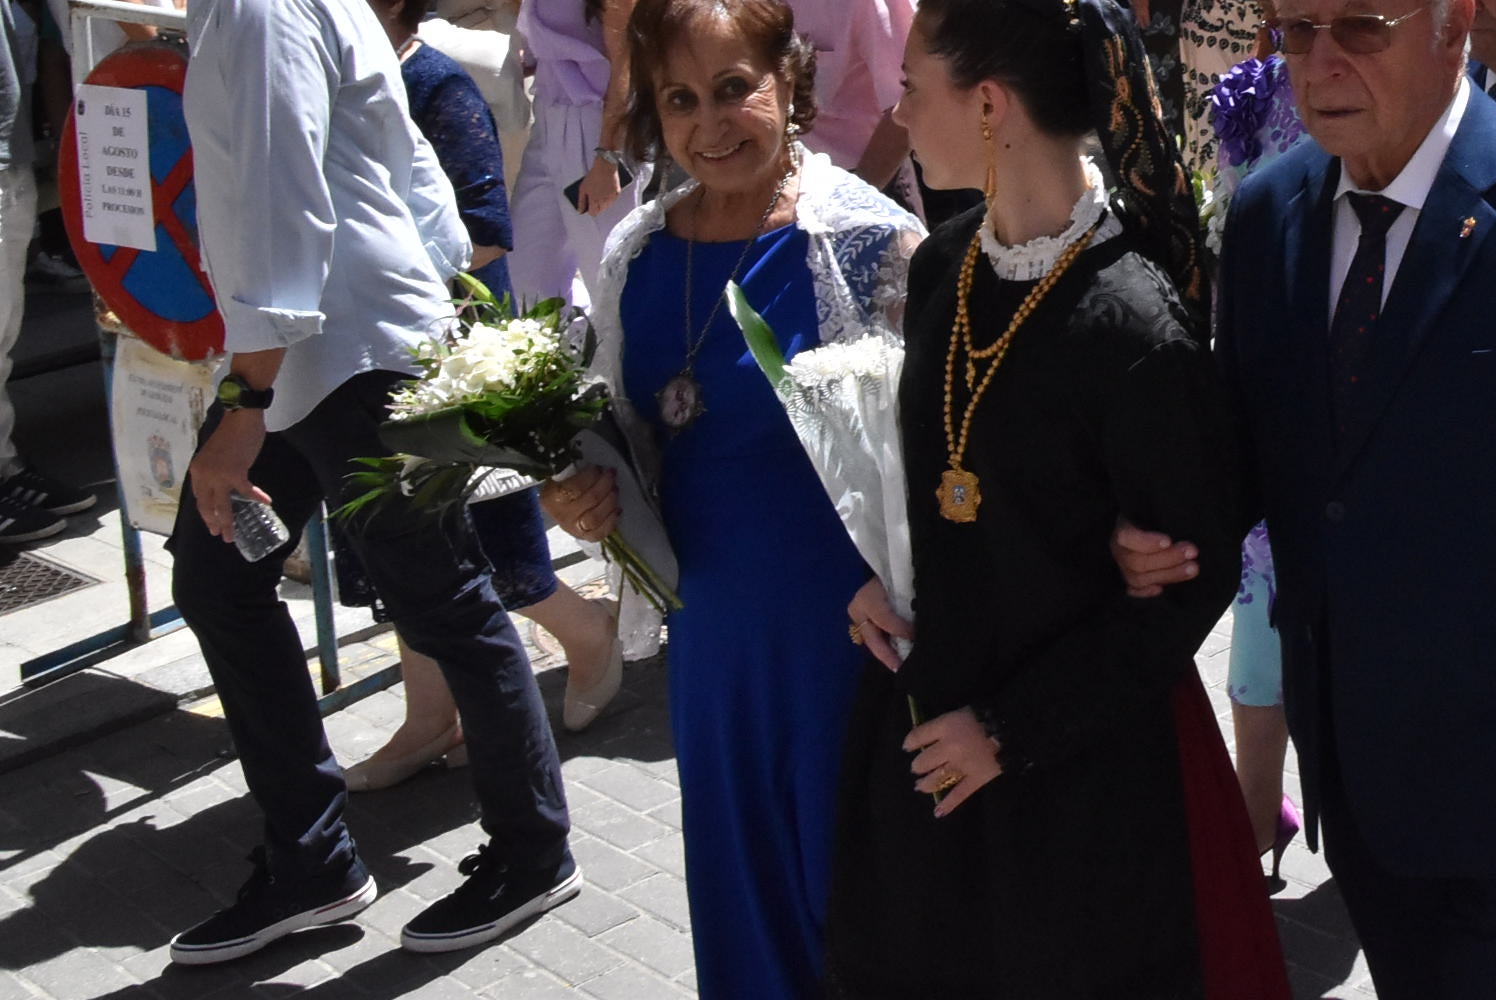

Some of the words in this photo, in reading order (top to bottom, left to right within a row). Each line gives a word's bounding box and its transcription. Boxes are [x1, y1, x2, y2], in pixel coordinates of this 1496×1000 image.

[112, 126, 124, 137] DE
[79, 132, 90, 169] Local
[102, 146, 138, 159] AGOSTO
[106, 166, 135, 179] DESDE
